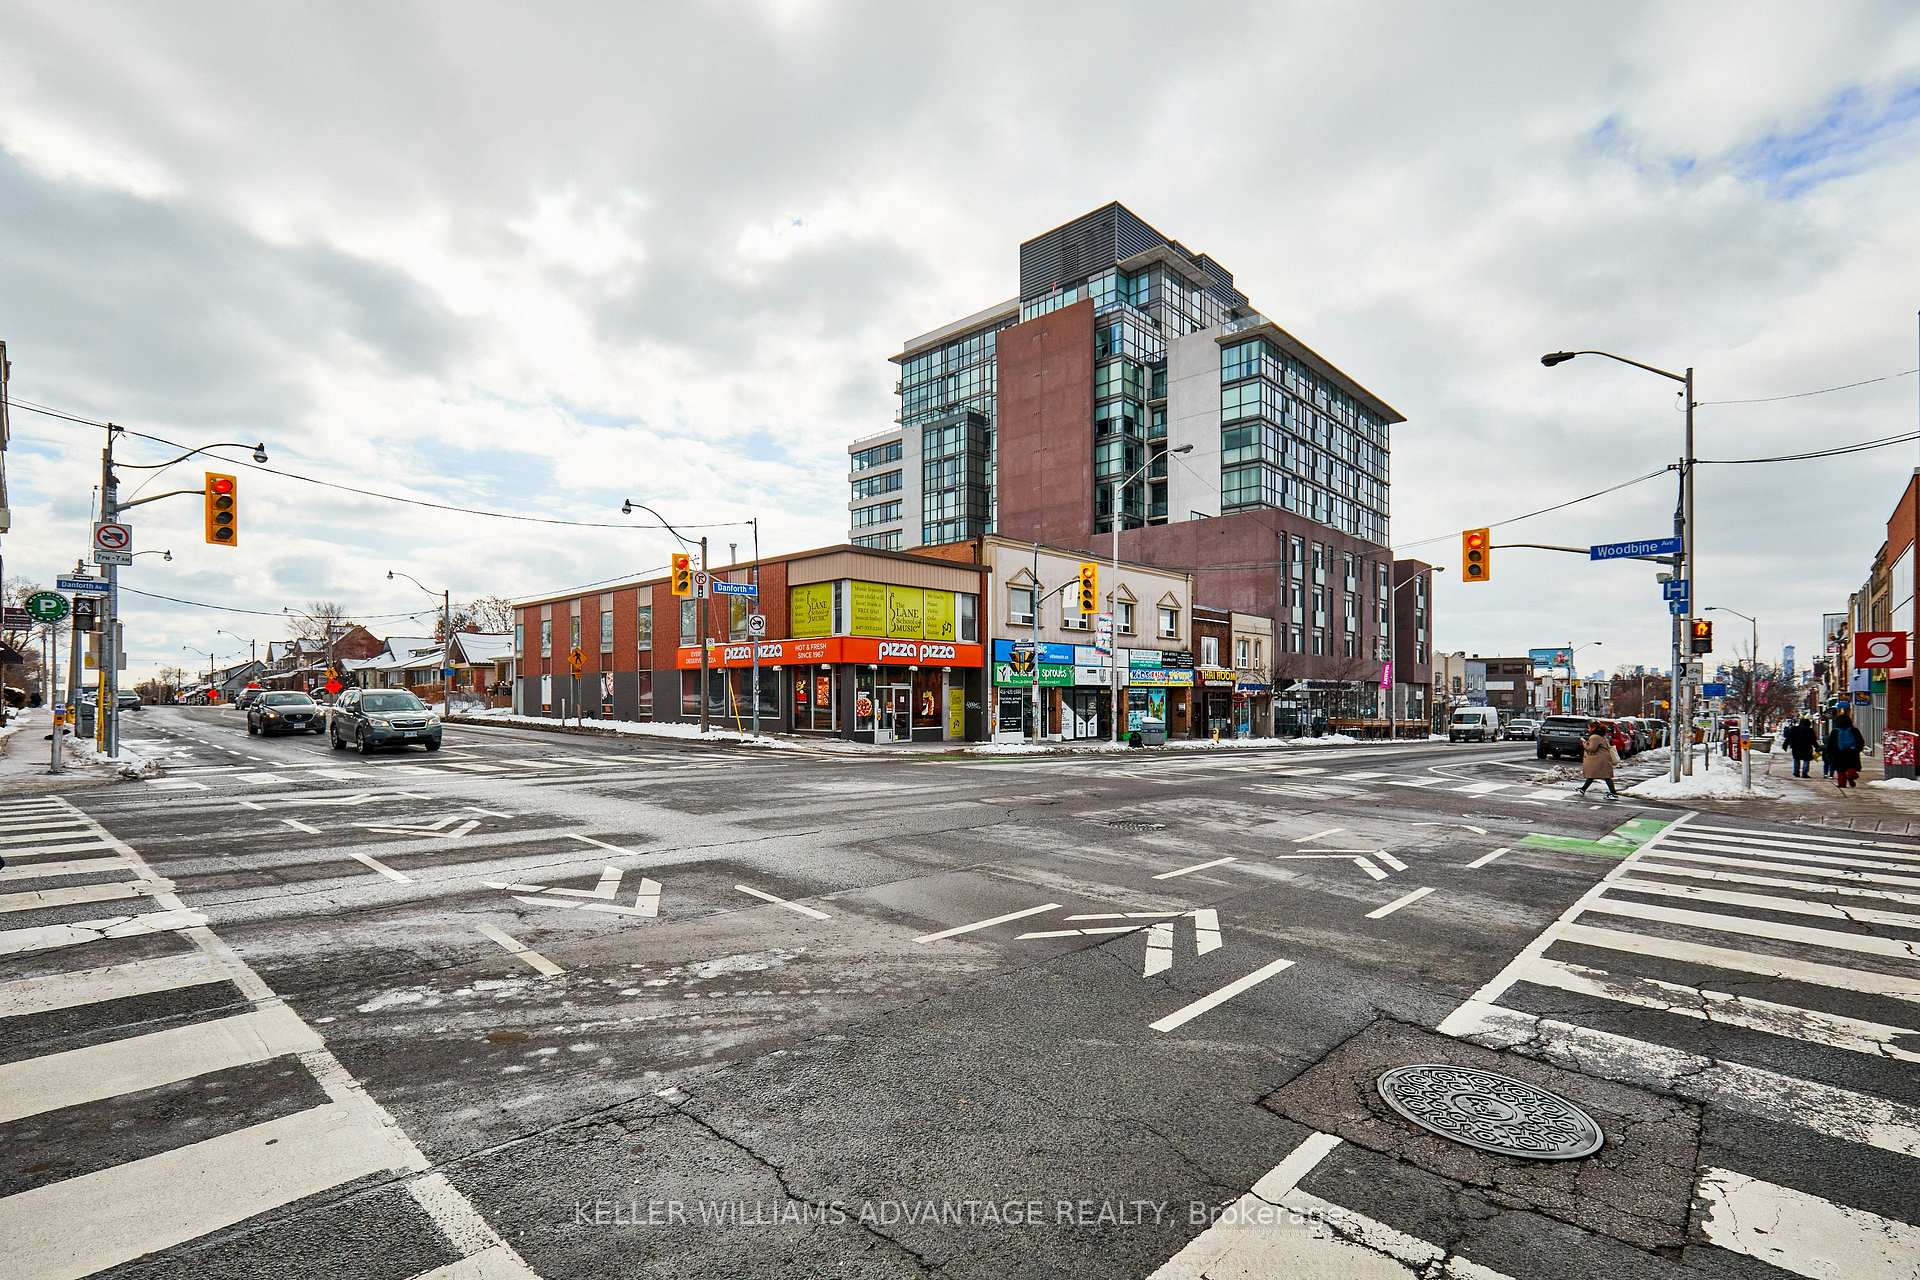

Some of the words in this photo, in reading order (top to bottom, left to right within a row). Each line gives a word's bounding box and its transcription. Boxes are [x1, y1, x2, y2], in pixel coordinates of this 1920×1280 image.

[1597, 543, 1658, 558] Woodbine
[61, 581, 94, 589] Danforth
[718, 583, 747, 593] Danforth
[1667, 582, 1685, 598] H
[40, 599, 57, 611] P
[896, 607, 919, 619] LANE
[896, 624, 919, 632] MUSIC
[795, 644, 806, 652] HOT
[810, 642, 827, 651] FRESH
[879, 641, 917, 662] pizza
[920, 644, 955, 663] pizza
[724, 646, 752, 665] pizza
[797, 652, 812, 660] SINCE
[812, 651, 824, 659] 1967
[1041, 666, 1067, 680] sprouts
[1201, 670, 1216, 680] THAI
[1216, 671, 1237, 681] ROOM
